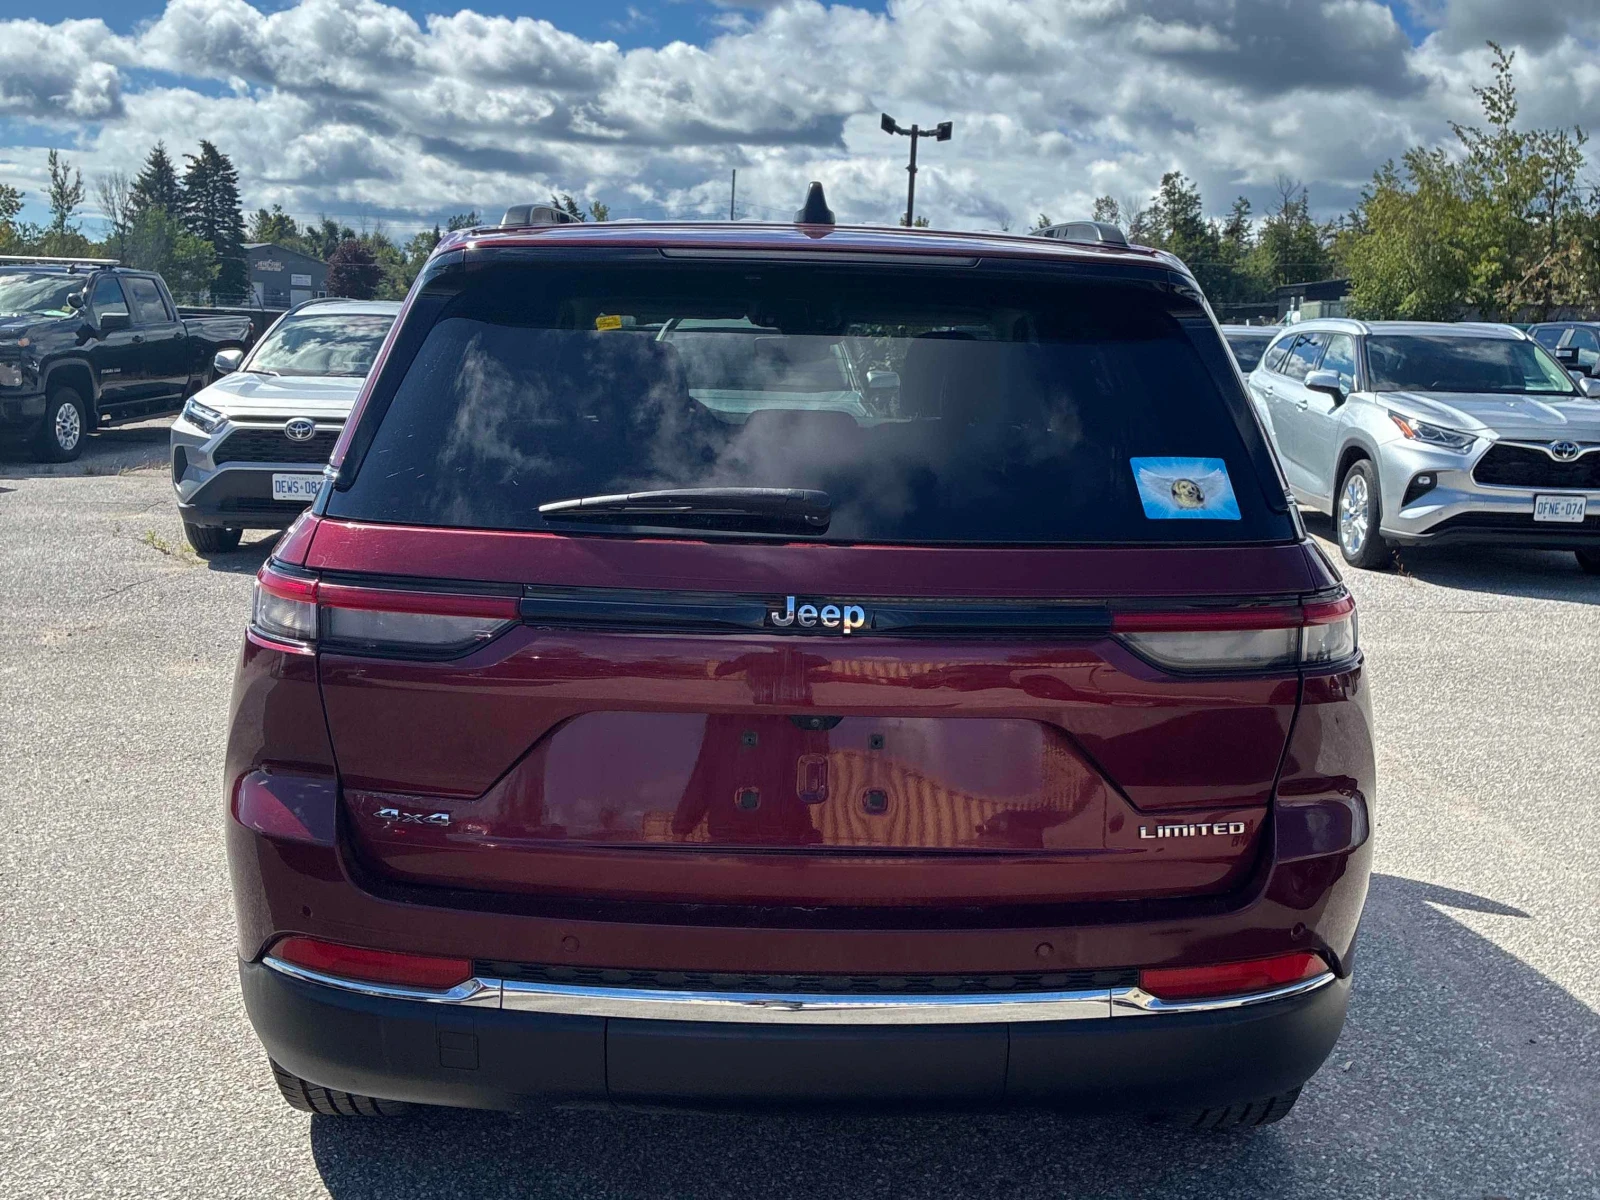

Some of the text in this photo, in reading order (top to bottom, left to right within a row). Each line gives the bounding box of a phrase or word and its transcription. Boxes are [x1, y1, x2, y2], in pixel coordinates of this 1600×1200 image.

[275, 480, 321, 494] DEWS 08
[1565, 503, 1583, 516] 074
[771, 596, 865, 634] Jeep
[372, 808, 452, 827] 4x4
[1139, 822, 1245, 839] LIMITED
